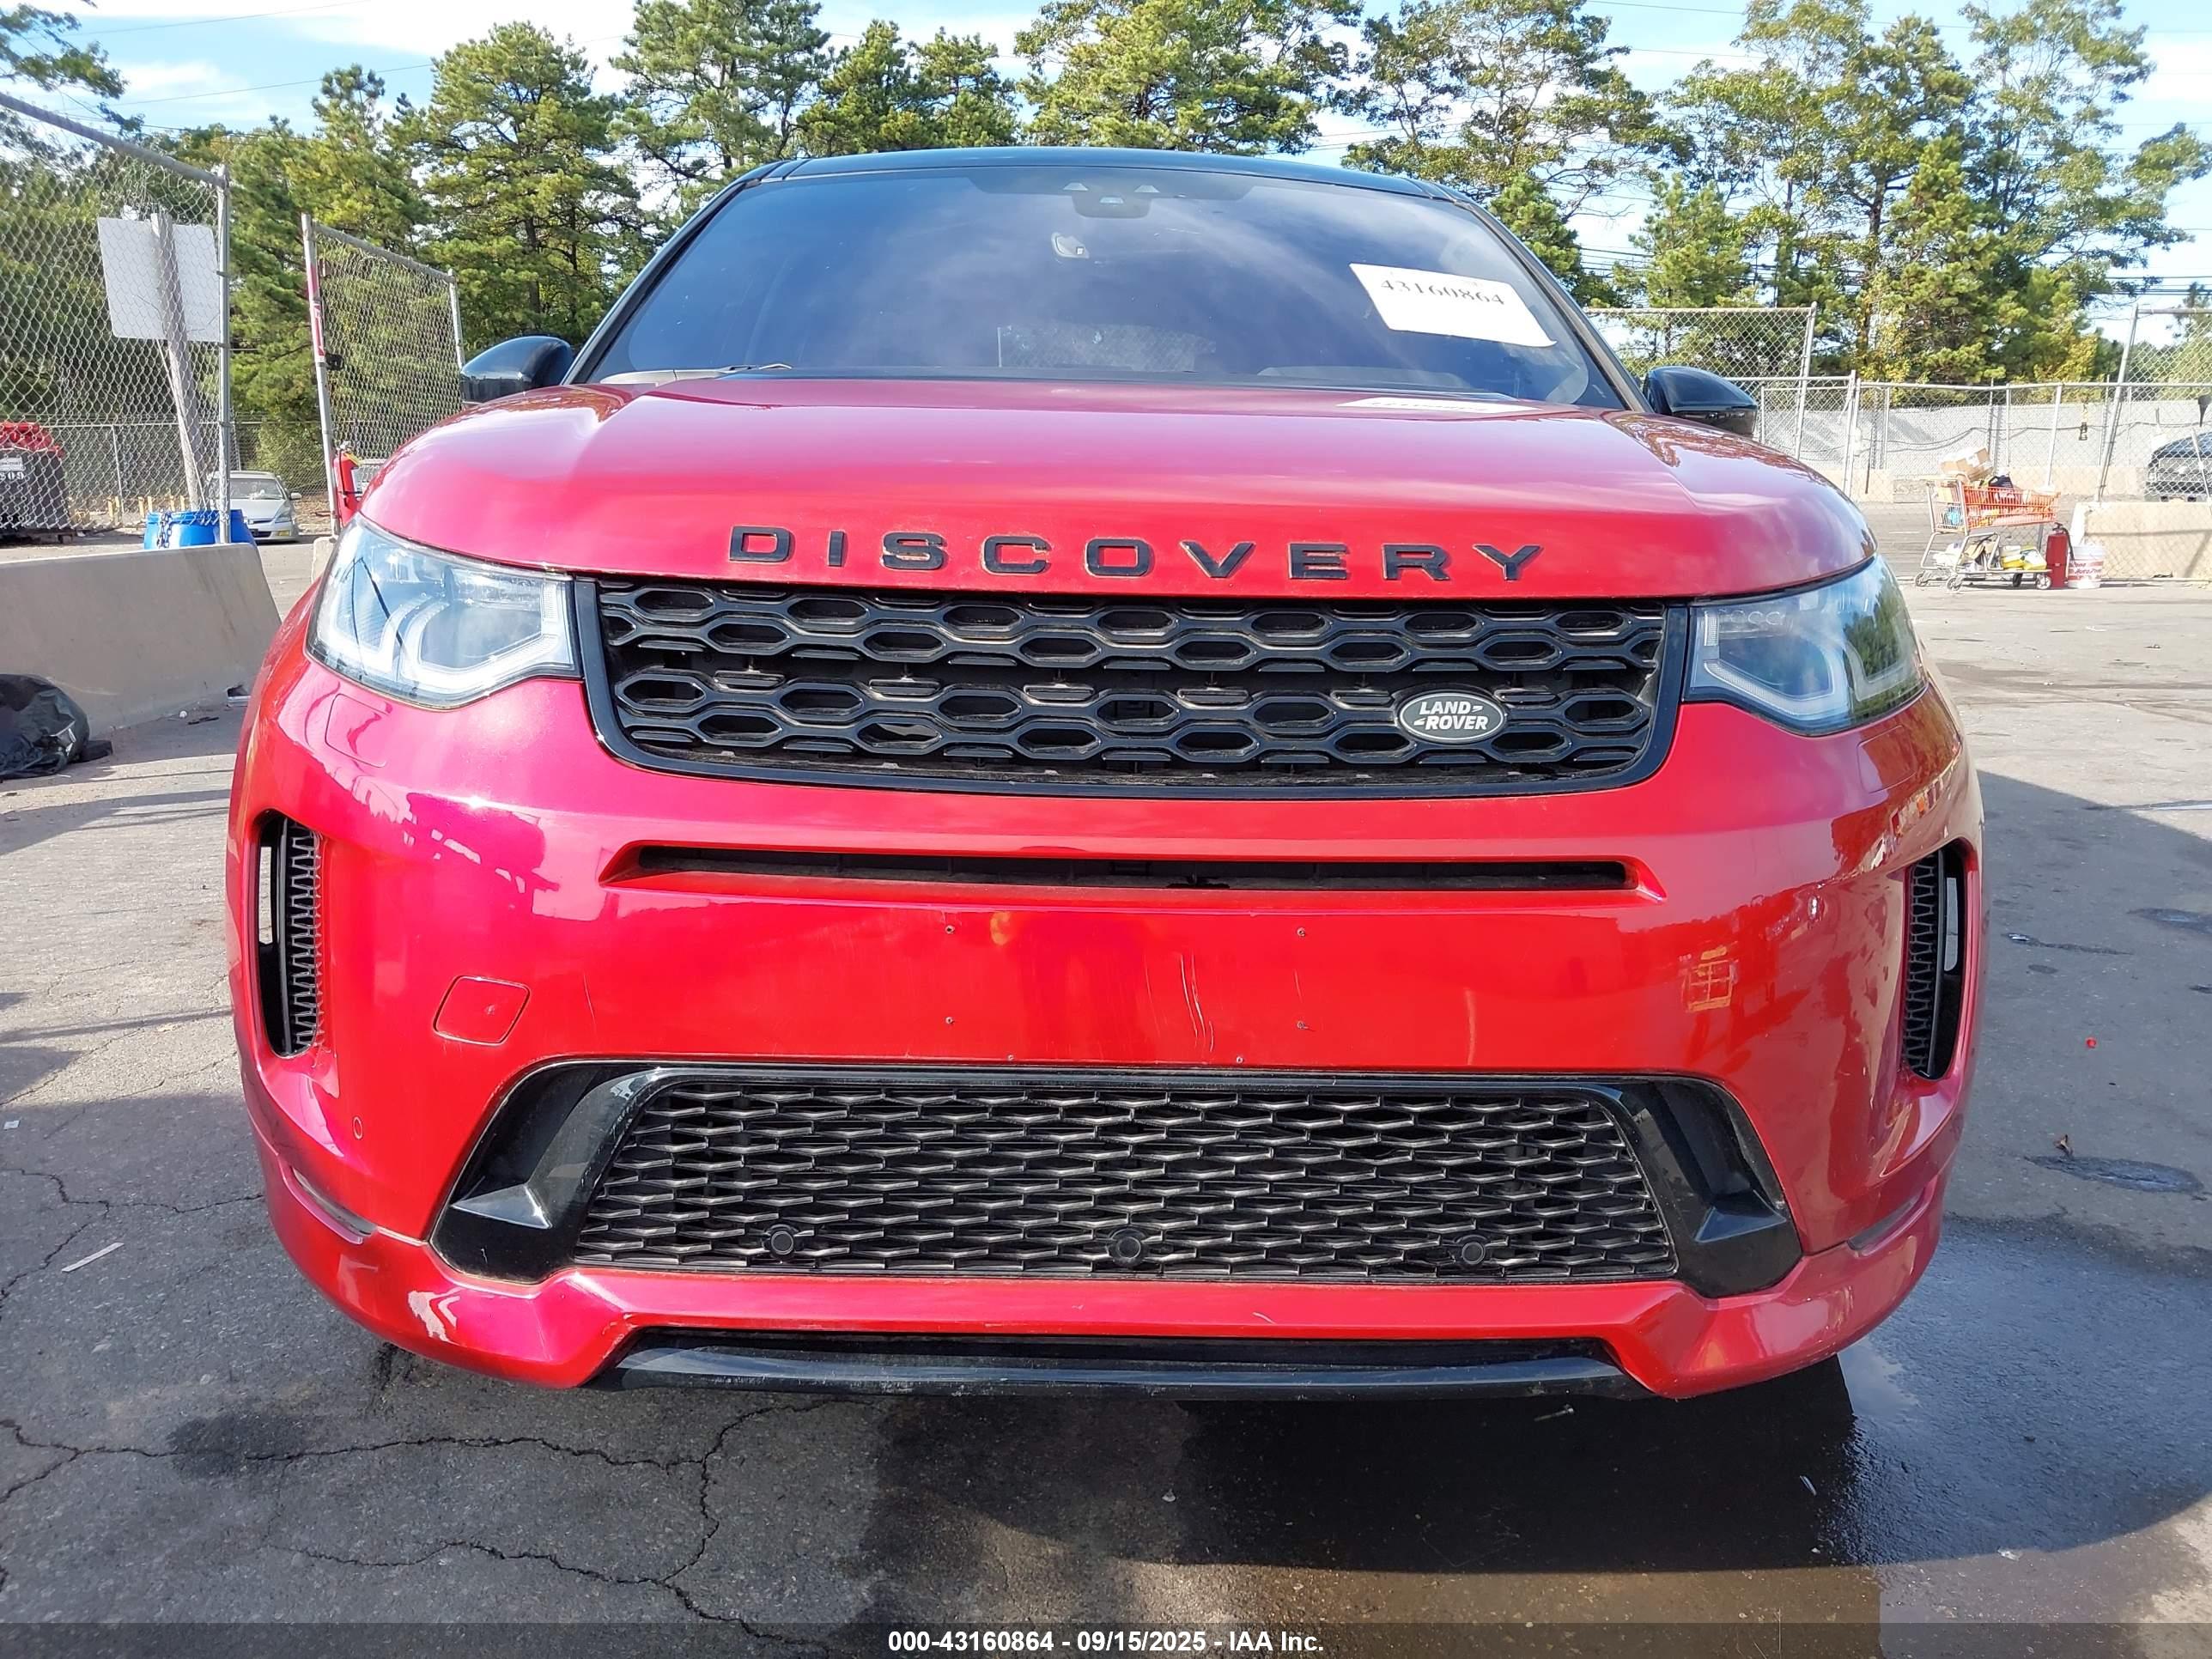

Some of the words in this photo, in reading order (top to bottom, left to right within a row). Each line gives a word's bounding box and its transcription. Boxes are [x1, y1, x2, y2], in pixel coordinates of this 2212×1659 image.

[1381, 279, 1504, 305] 43160864
[729, 526, 1543, 580] DISCOVERY
[1419, 701, 1472, 715] LAND
[1425, 715, 1488, 731] ROVER
